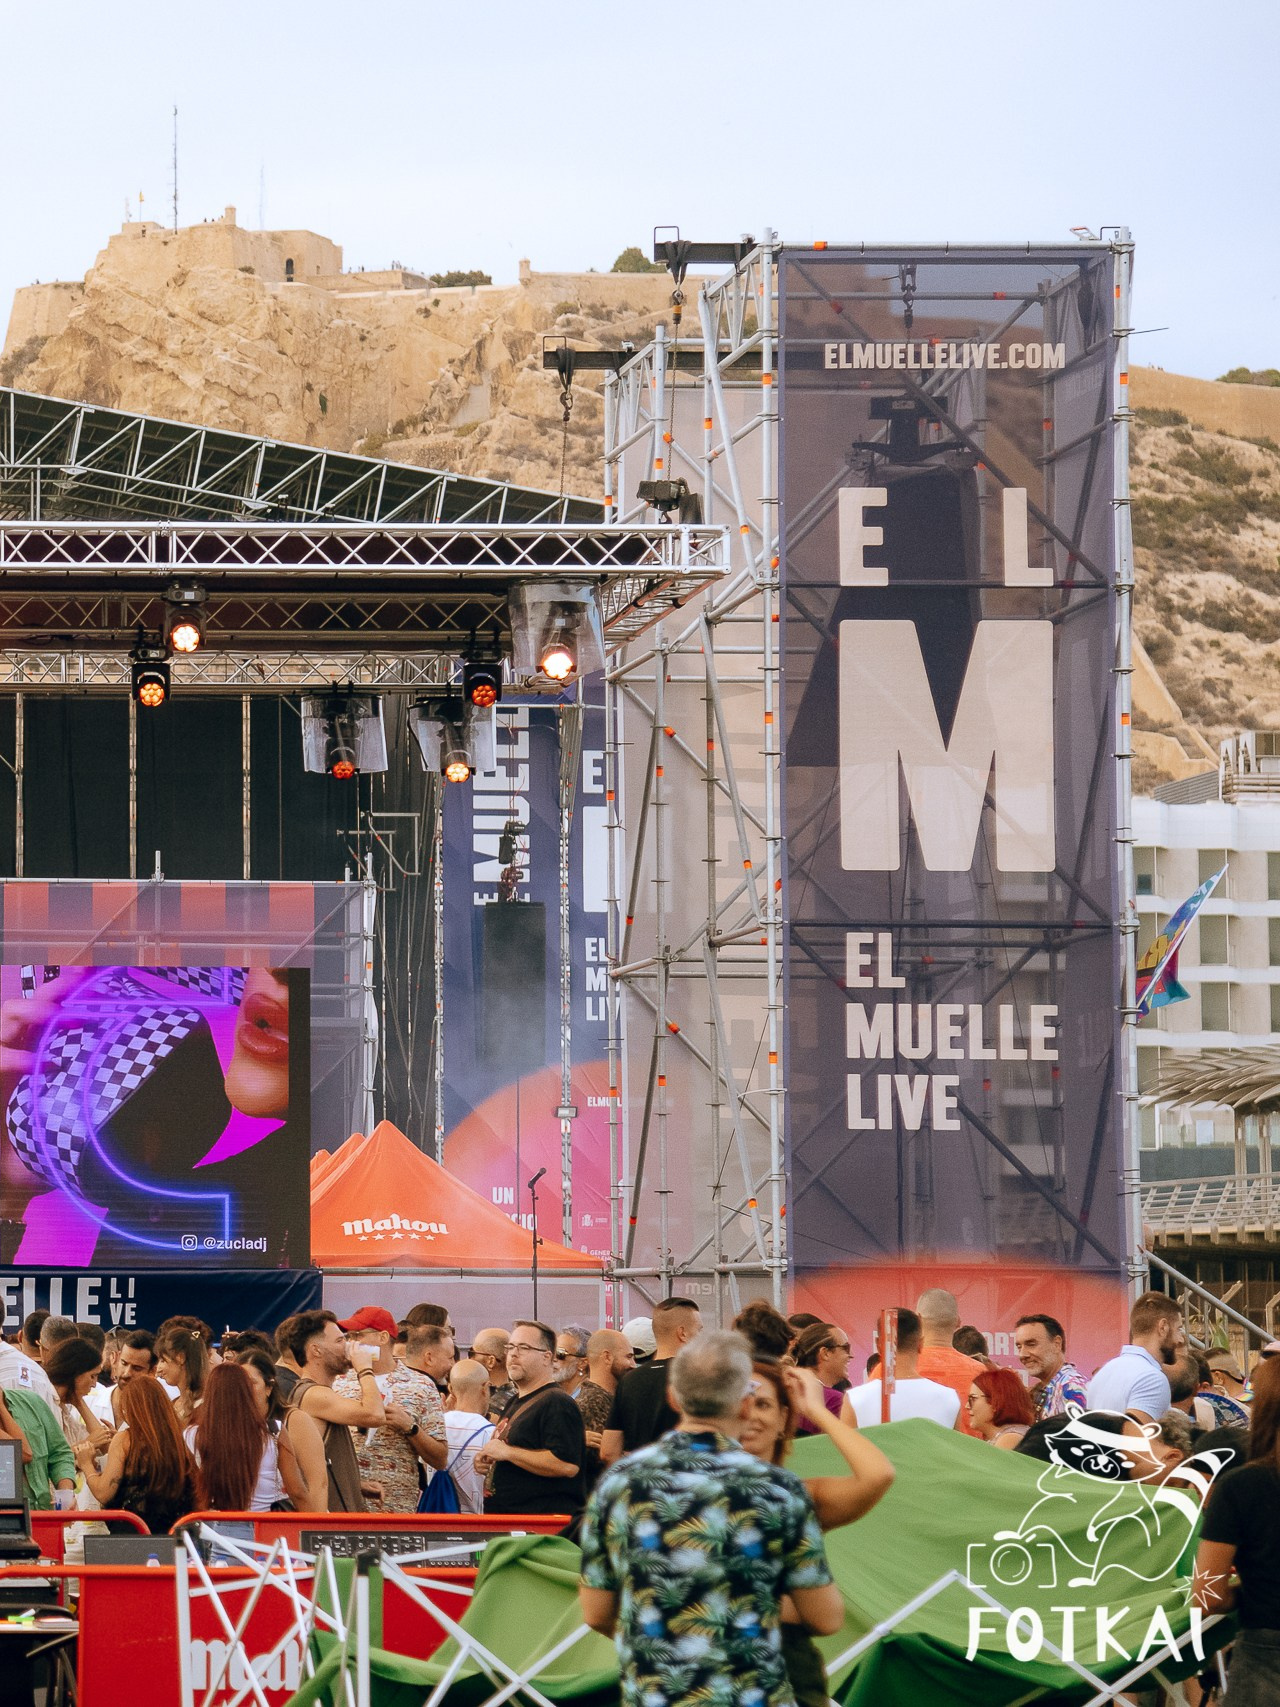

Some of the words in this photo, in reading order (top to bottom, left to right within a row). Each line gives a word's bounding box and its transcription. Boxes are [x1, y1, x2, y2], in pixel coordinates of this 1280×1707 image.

[824, 343, 1066, 369] ELMUELLELIVE.COM
[839, 619, 1056, 871] M
[846, 932, 906, 988] EL
[846, 1003, 1059, 1060] MUELLE
[846, 1073, 961, 1131] LIVE
[492, 1187, 514, 1204] UN
[203, 1237, 267, 1252] @zucladj
